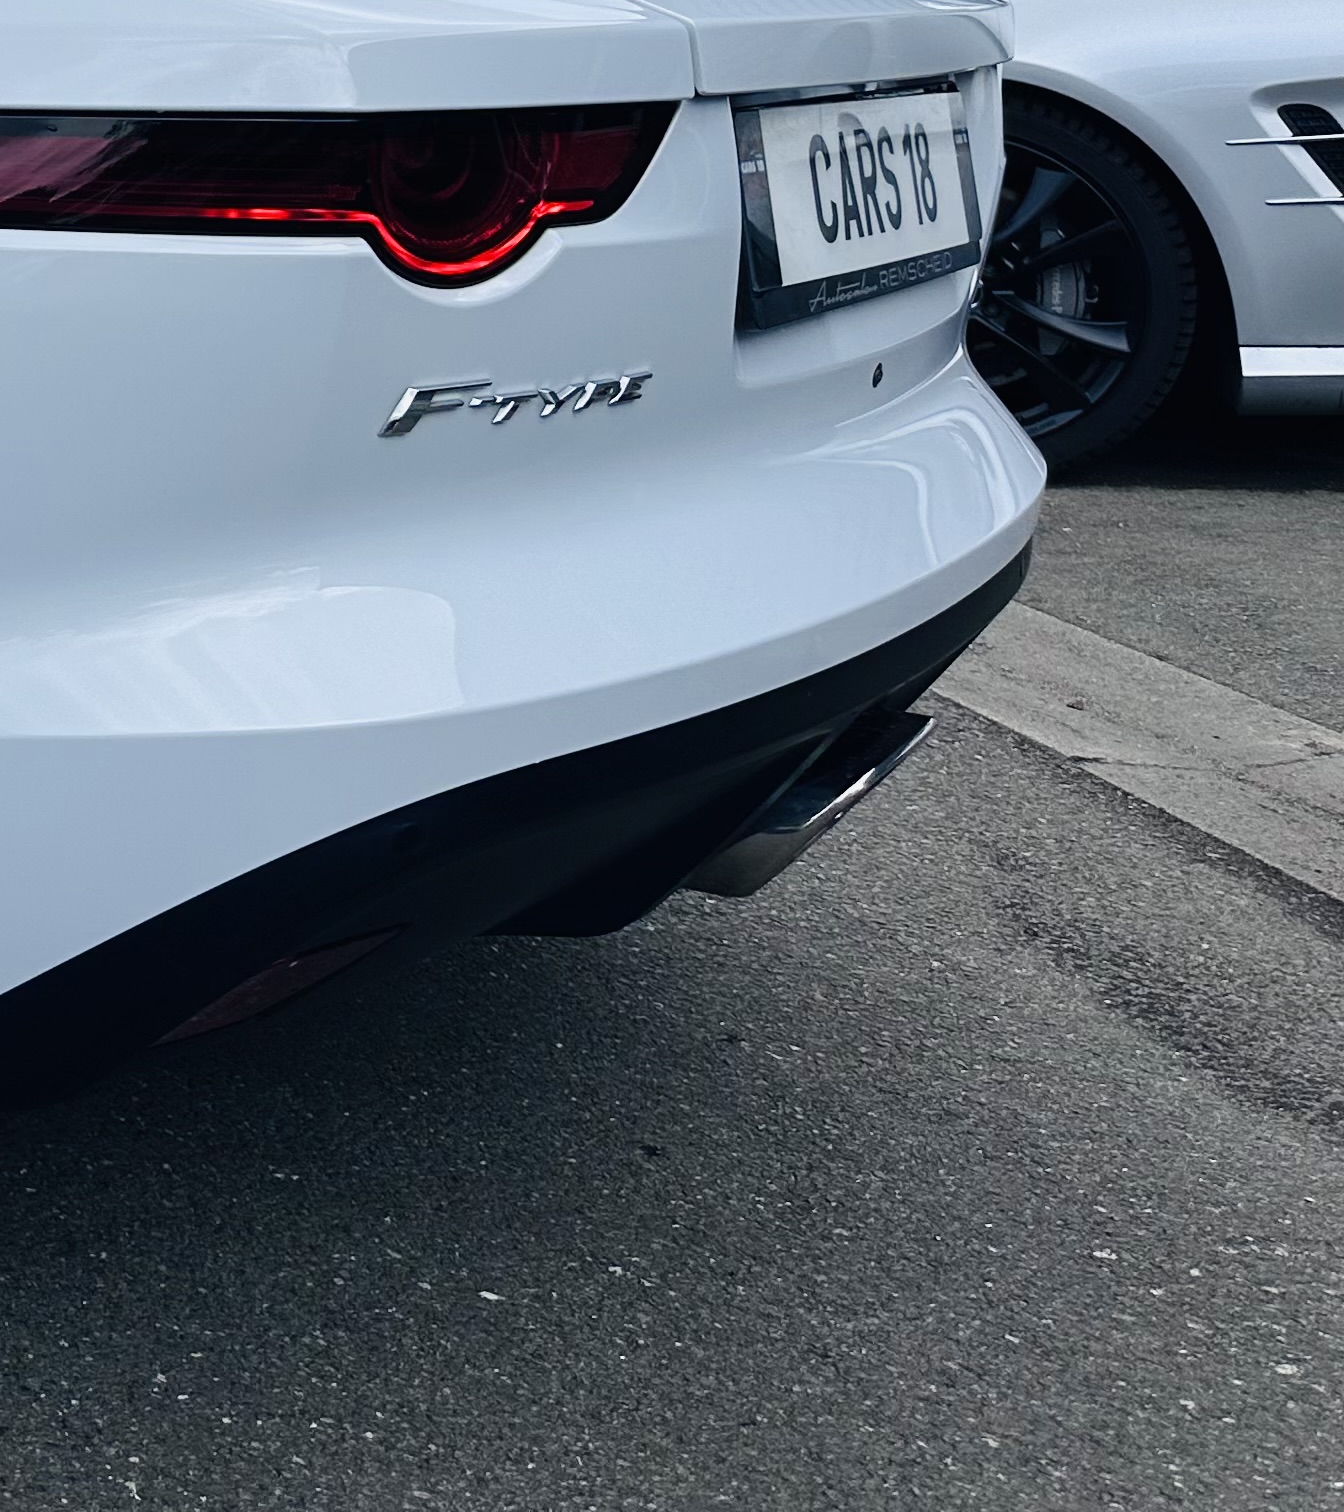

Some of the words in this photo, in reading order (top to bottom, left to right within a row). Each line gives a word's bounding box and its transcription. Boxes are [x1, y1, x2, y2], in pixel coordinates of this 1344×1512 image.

[808, 125, 902, 244] CARS
[902, 121, 938, 226] 18
[879, 251, 953, 289] REMSCHEID
[377, 370, 653, 438] F-TYPE
